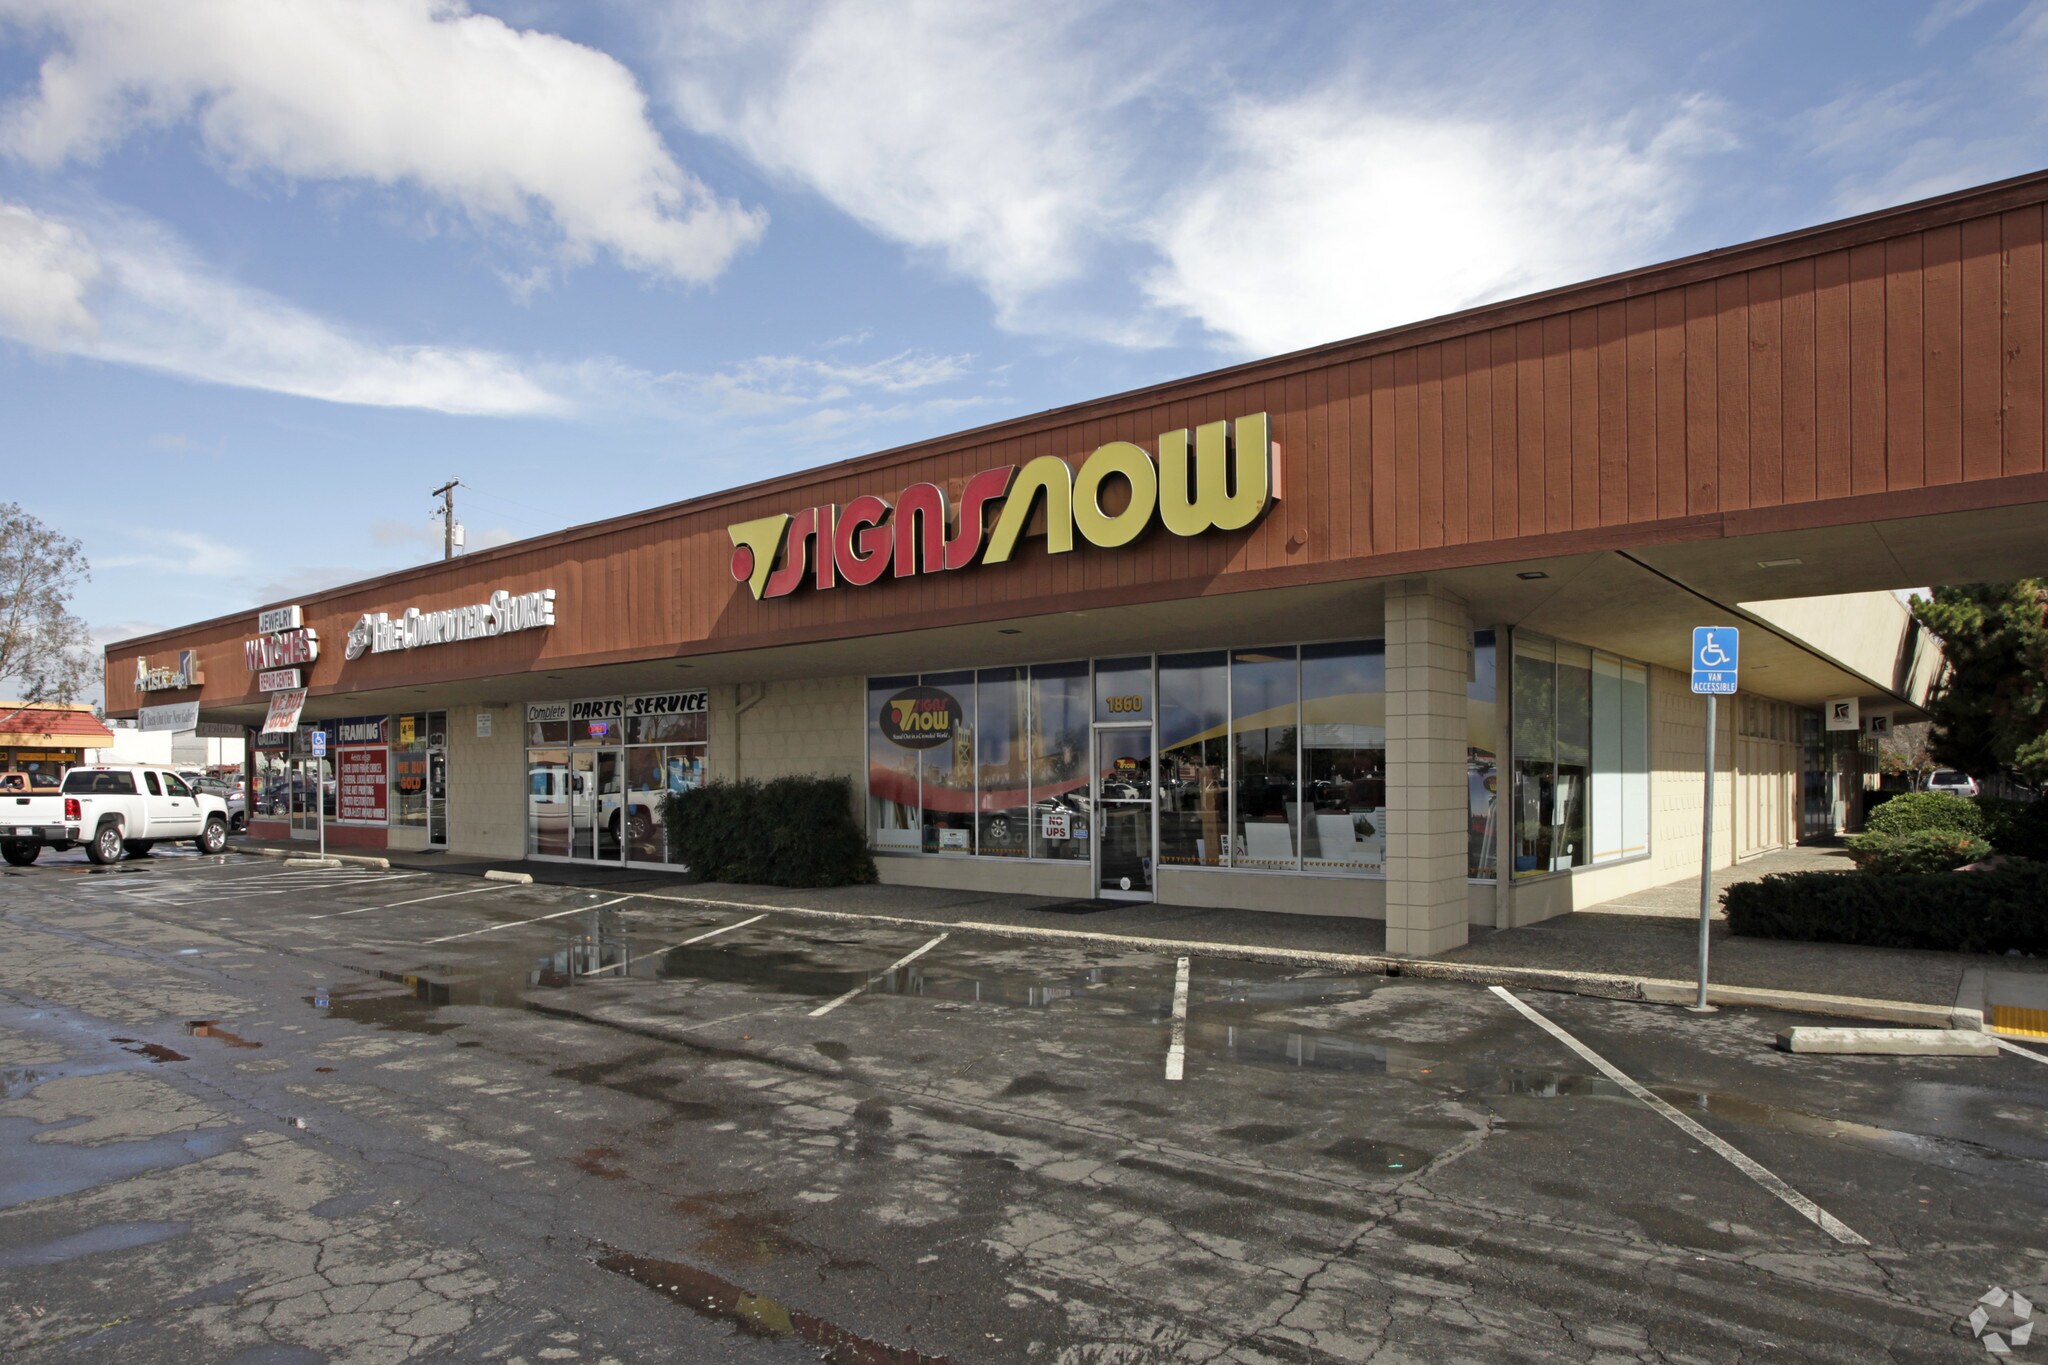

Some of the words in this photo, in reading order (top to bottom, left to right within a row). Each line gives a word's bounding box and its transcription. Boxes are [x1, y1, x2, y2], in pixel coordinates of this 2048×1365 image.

[764, 464, 1022, 598] SIGNS
[260, 608, 293, 632] JEWELRY
[402, 608, 491, 649] COMPUTER
[490, 589, 555, 636] STORE
[244, 628, 316, 671] WATCHES
[260, 672, 276, 690] REPAIR
[276, 671, 294, 688] CENTER
[1708, 672, 1722, 681] VAN
[1694, 682, 1735, 691] ACCESSIBLE
[272, 694, 286, 711] WE
[285, 692, 304, 709] BUY
[529, 704, 566, 721] Complete
[572, 700, 623, 719] PARTS
[634, 692, 707, 714] SERVICE
[1106, 695, 1142, 713] 1860
[258, 731, 284, 746] GALLERY
[339, 723, 378, 741] FRAMING
[397, 761, 409, 773] WE
[411, 761, 427, 773] BUY
[401, 777, 421, 790] GOLD
[1048, 816, 1064, 826] NO
[1046, 828, 1066, 837] UPS
